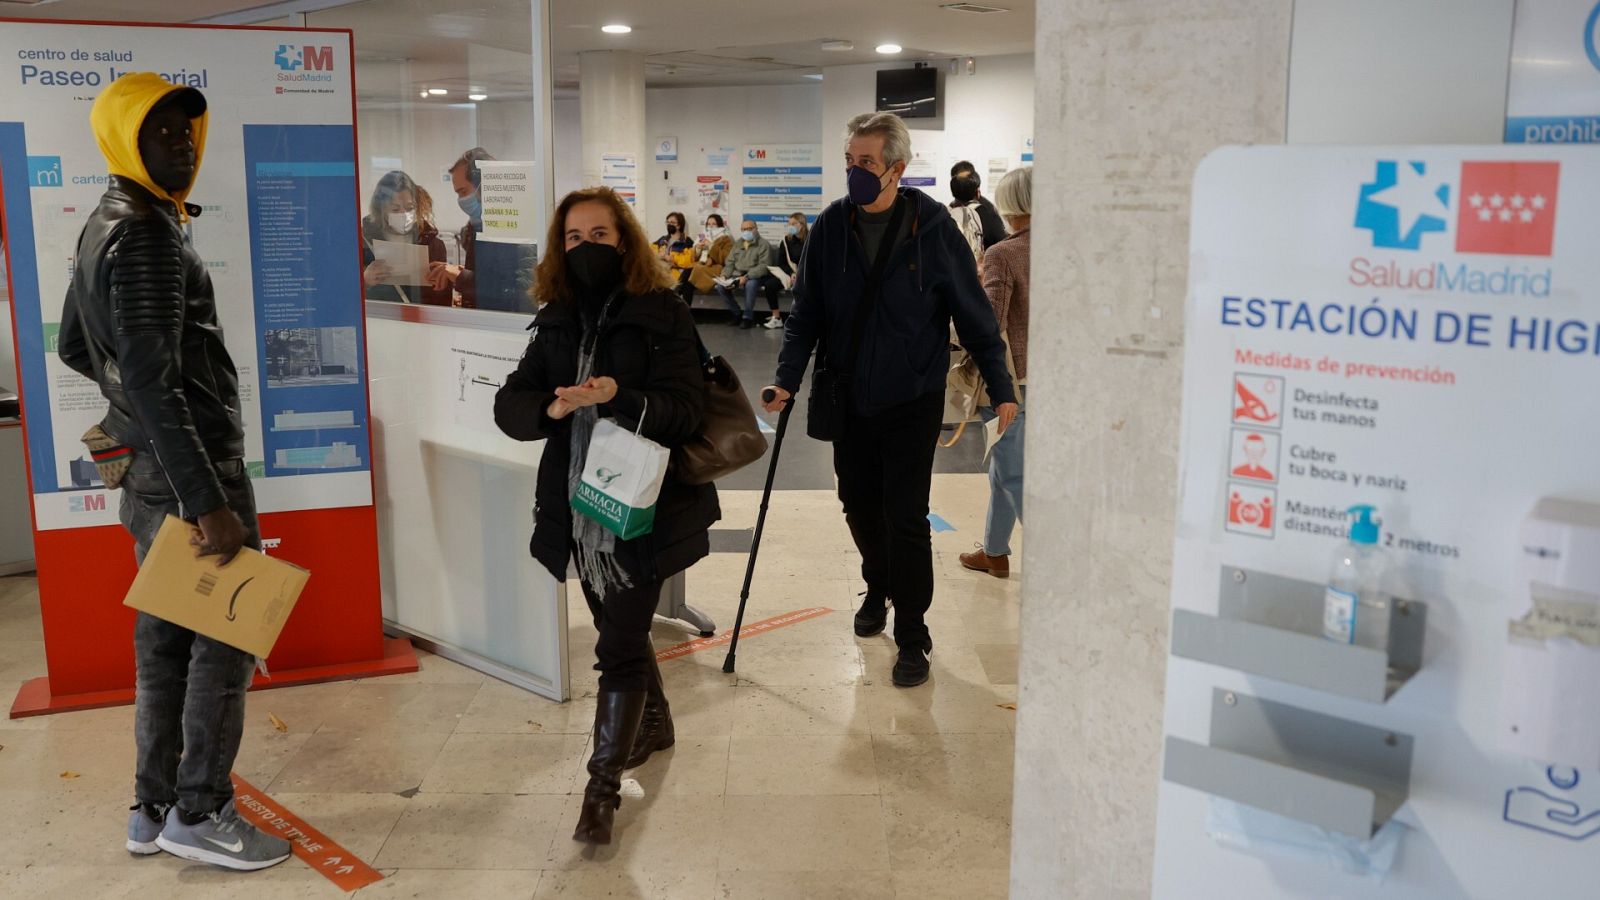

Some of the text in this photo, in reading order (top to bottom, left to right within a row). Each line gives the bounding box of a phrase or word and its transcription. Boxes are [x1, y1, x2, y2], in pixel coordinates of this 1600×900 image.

[18, 49, 133, 62] centro de salud
[20, 64, 208, 88] Paseo Ierial
[277, 73, 332, 81] SaludMadrid
[1525, 118, 1600, 145] prohib
[72, 174, 110, 184] carter
[1348, 257, 1552, 298] SaludMadrid
[1220, 296, 1418, 341] ESTACIÓN
[1434, 311, 1492, 347] DE
[1235, 348, 1456, 385] Medidas de prevención
[1293, 388, 1379, 412] Desinfecta
[1292, 406, 1376, 429] tus manos
[1290, 444, 1336, 464] Cubre
[1288, 462, 1408, 491] tu boca y nariz
[578, 484, 622, 517] ARMACIA
[1285, 501, 1347, 521] Mantén
[1385, 532, 1394, 546] 2
[1398, 537, 1460, 558] metros
[237, 794, 277, 820] PUESTO
[271, 818, 291, 830] DE
